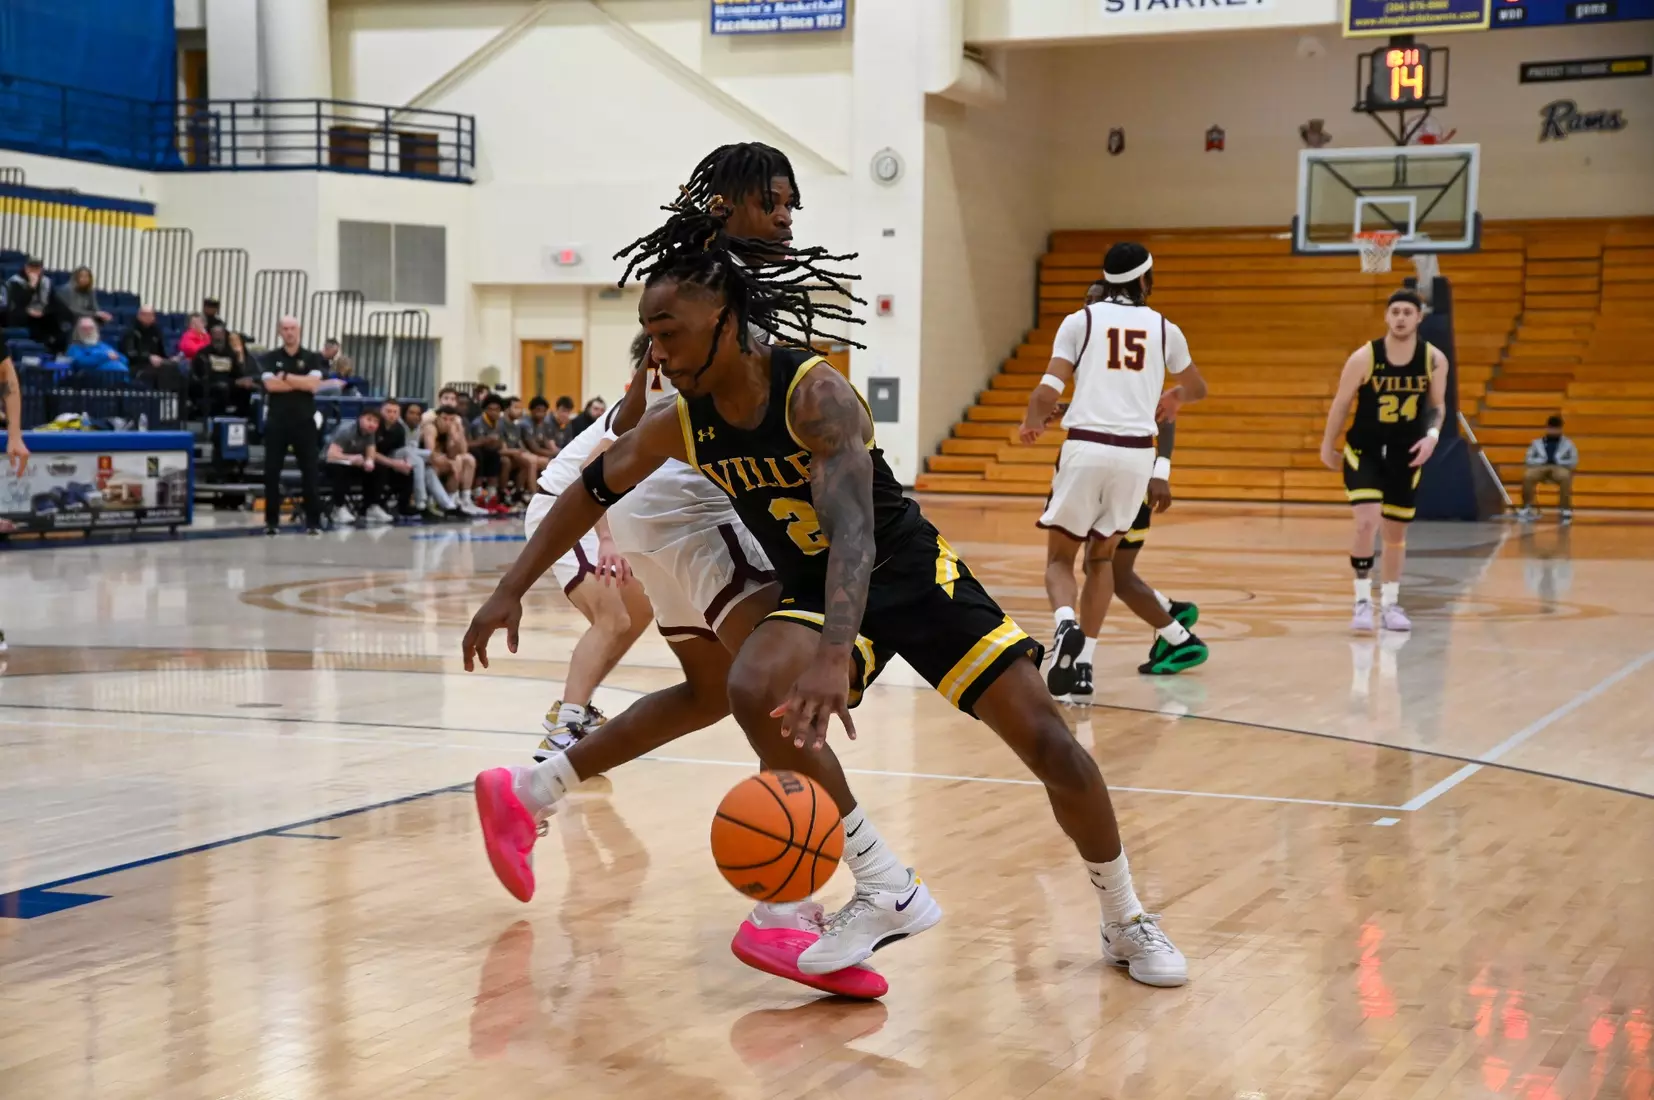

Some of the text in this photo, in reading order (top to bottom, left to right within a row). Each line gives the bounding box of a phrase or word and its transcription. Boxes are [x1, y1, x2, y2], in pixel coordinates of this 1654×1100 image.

[1576, 4, 1607, 18] game
[1391, 64, 1423, 101] 14
[1538, 99, 1628, 143] Rams
[1107, 327, 1147, 372] 15
[1371, 375, 1428, 393] VILLE
[1378, 394, 1420, 422] 24
[768, 497, 829, 556] 2
